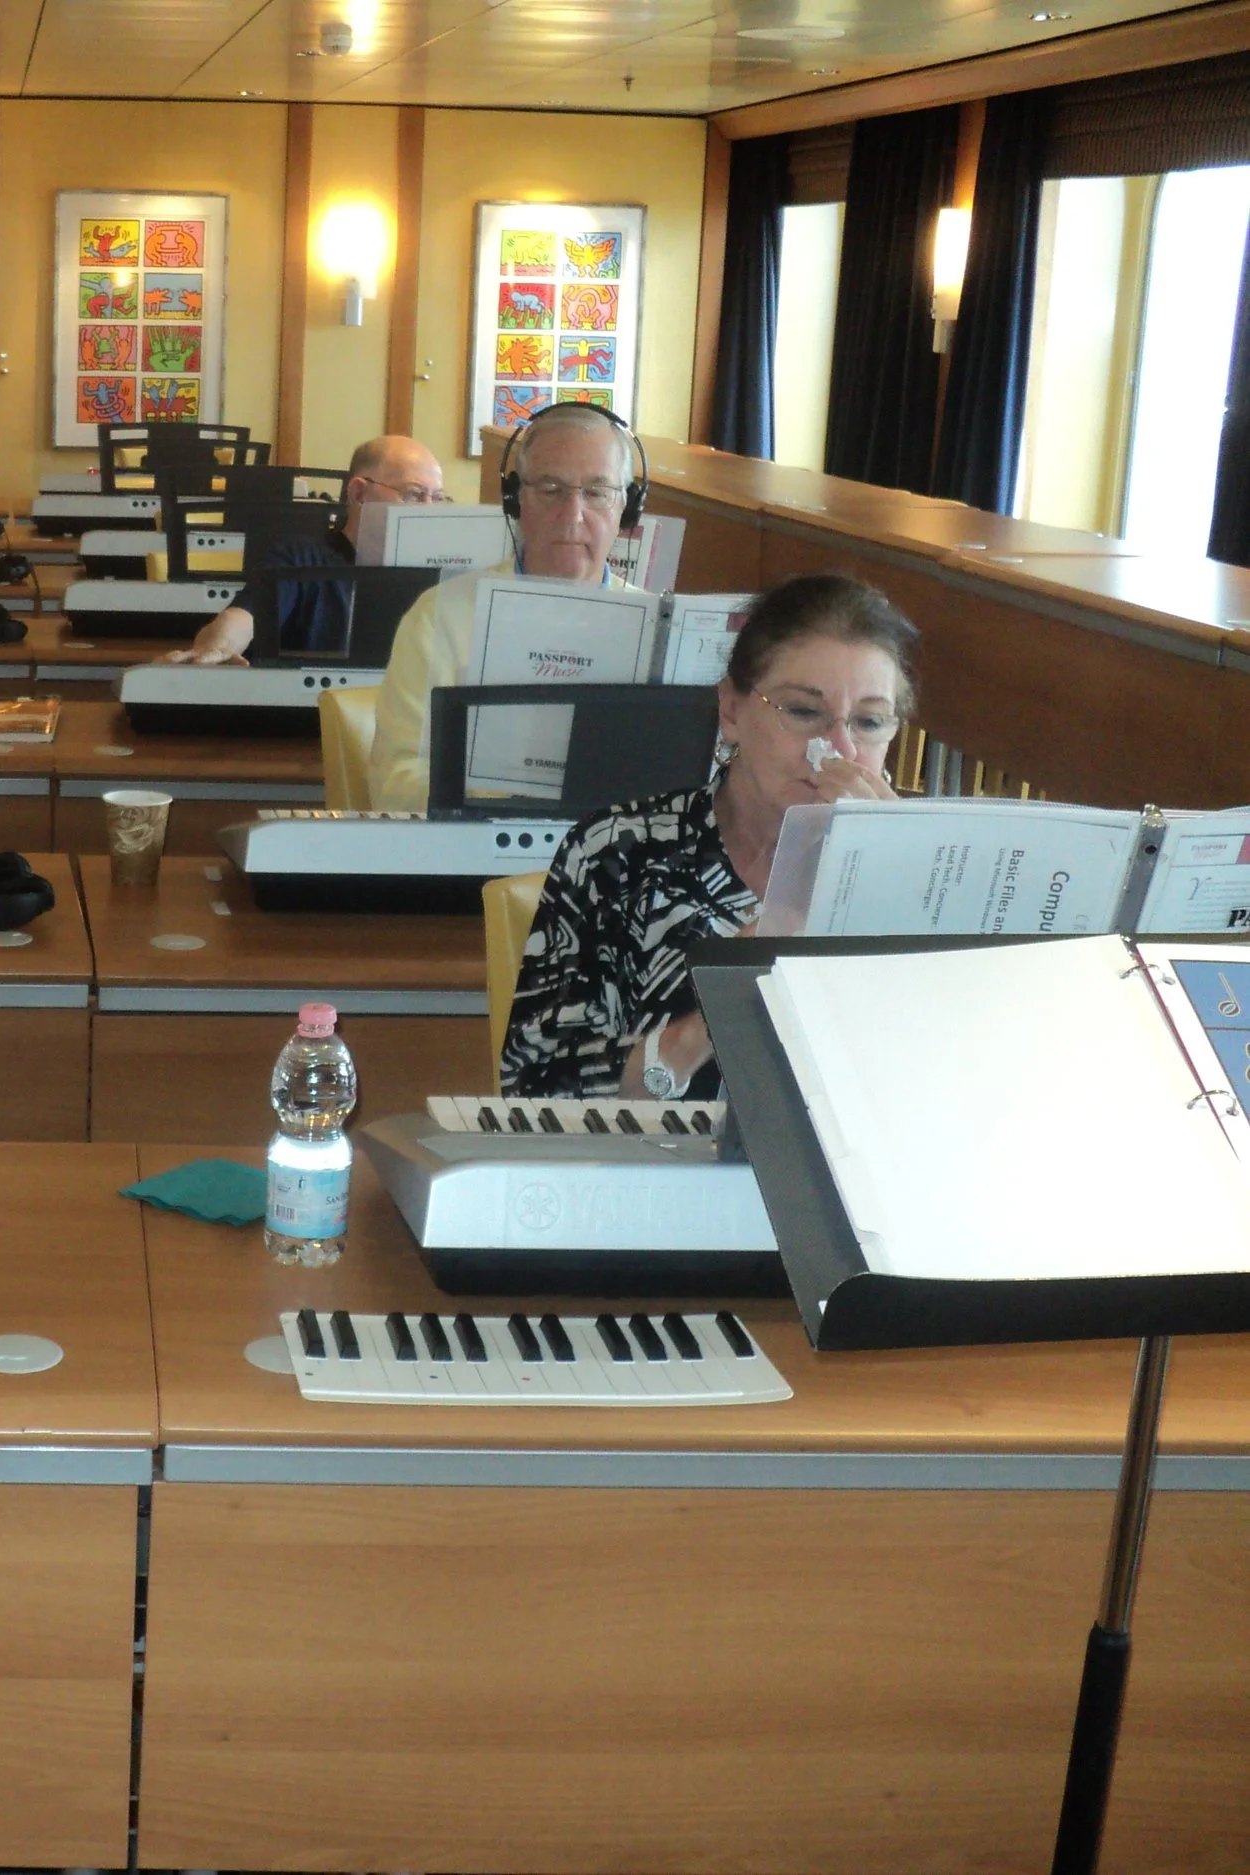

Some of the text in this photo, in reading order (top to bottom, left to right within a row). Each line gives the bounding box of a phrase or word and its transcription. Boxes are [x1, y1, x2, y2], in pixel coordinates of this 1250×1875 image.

[529, 651, 595, 668] PASSPORT
[1006, 849, 1025, 882] Basic
[998, 885, 1016, 913] Files
[1038, 871, 1070, 933] Compu
